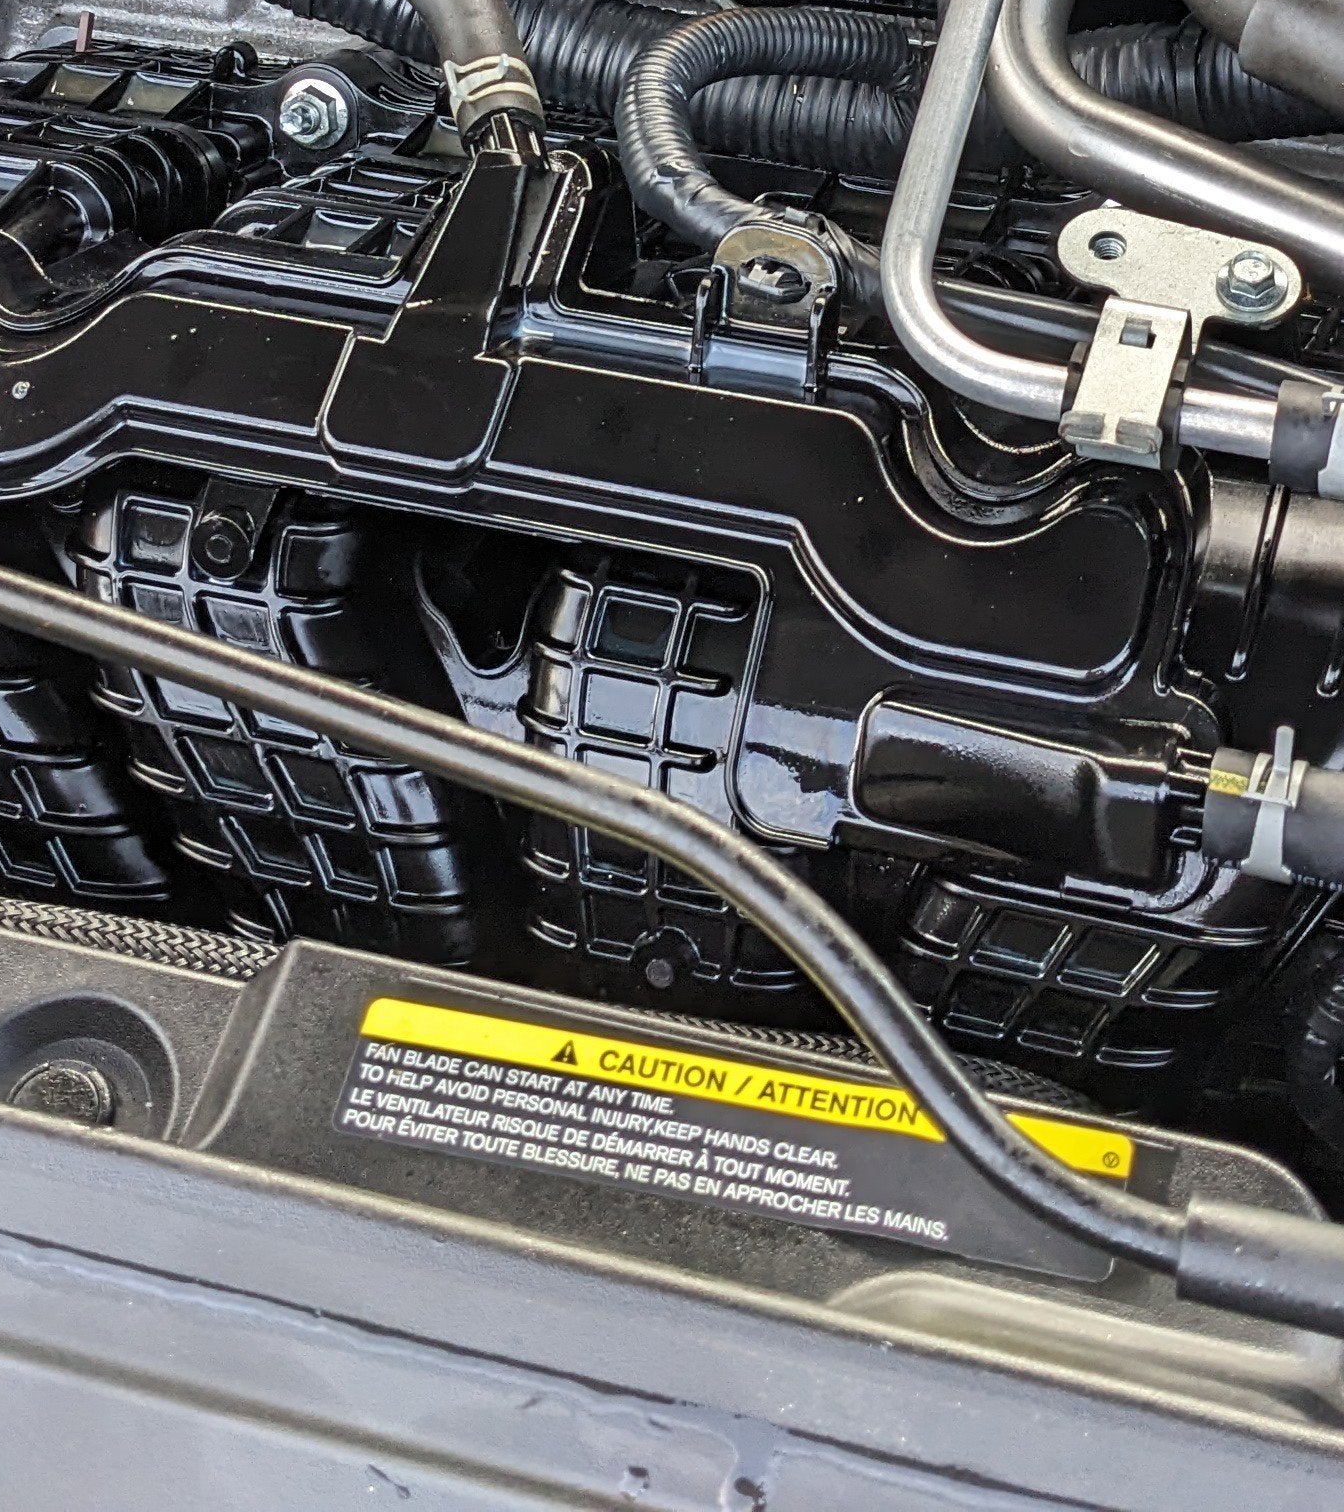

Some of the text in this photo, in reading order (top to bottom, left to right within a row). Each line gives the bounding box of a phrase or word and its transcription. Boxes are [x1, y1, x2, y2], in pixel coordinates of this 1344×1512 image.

[359, 1062, 385, 1083] TO
[386, 1069, 434, 1091] HELP
[434, 1079, 490, 1102] AVOID
[492, 1087, 588, 1122] PERSONAL
[703, 1127, 771, 1156] HANDS
[773, 1141, 839, 1170] CLEAR.
[365, 1042, 676, 1115] FAN BLADE CAN START AT ANY TIME.
[599, 1049, 921, 1126] CAUTION / ATTENTION
[342, 1108, 950, 1242] POUR ÉVITER TOUTE BLESSURE, NE PAS EN APPROCHER LES MAINS.
[349, 1087, 851, 1198] LE VENTILATEUR RISQUE DE DÉMARRER À TOUT MOMENT.
